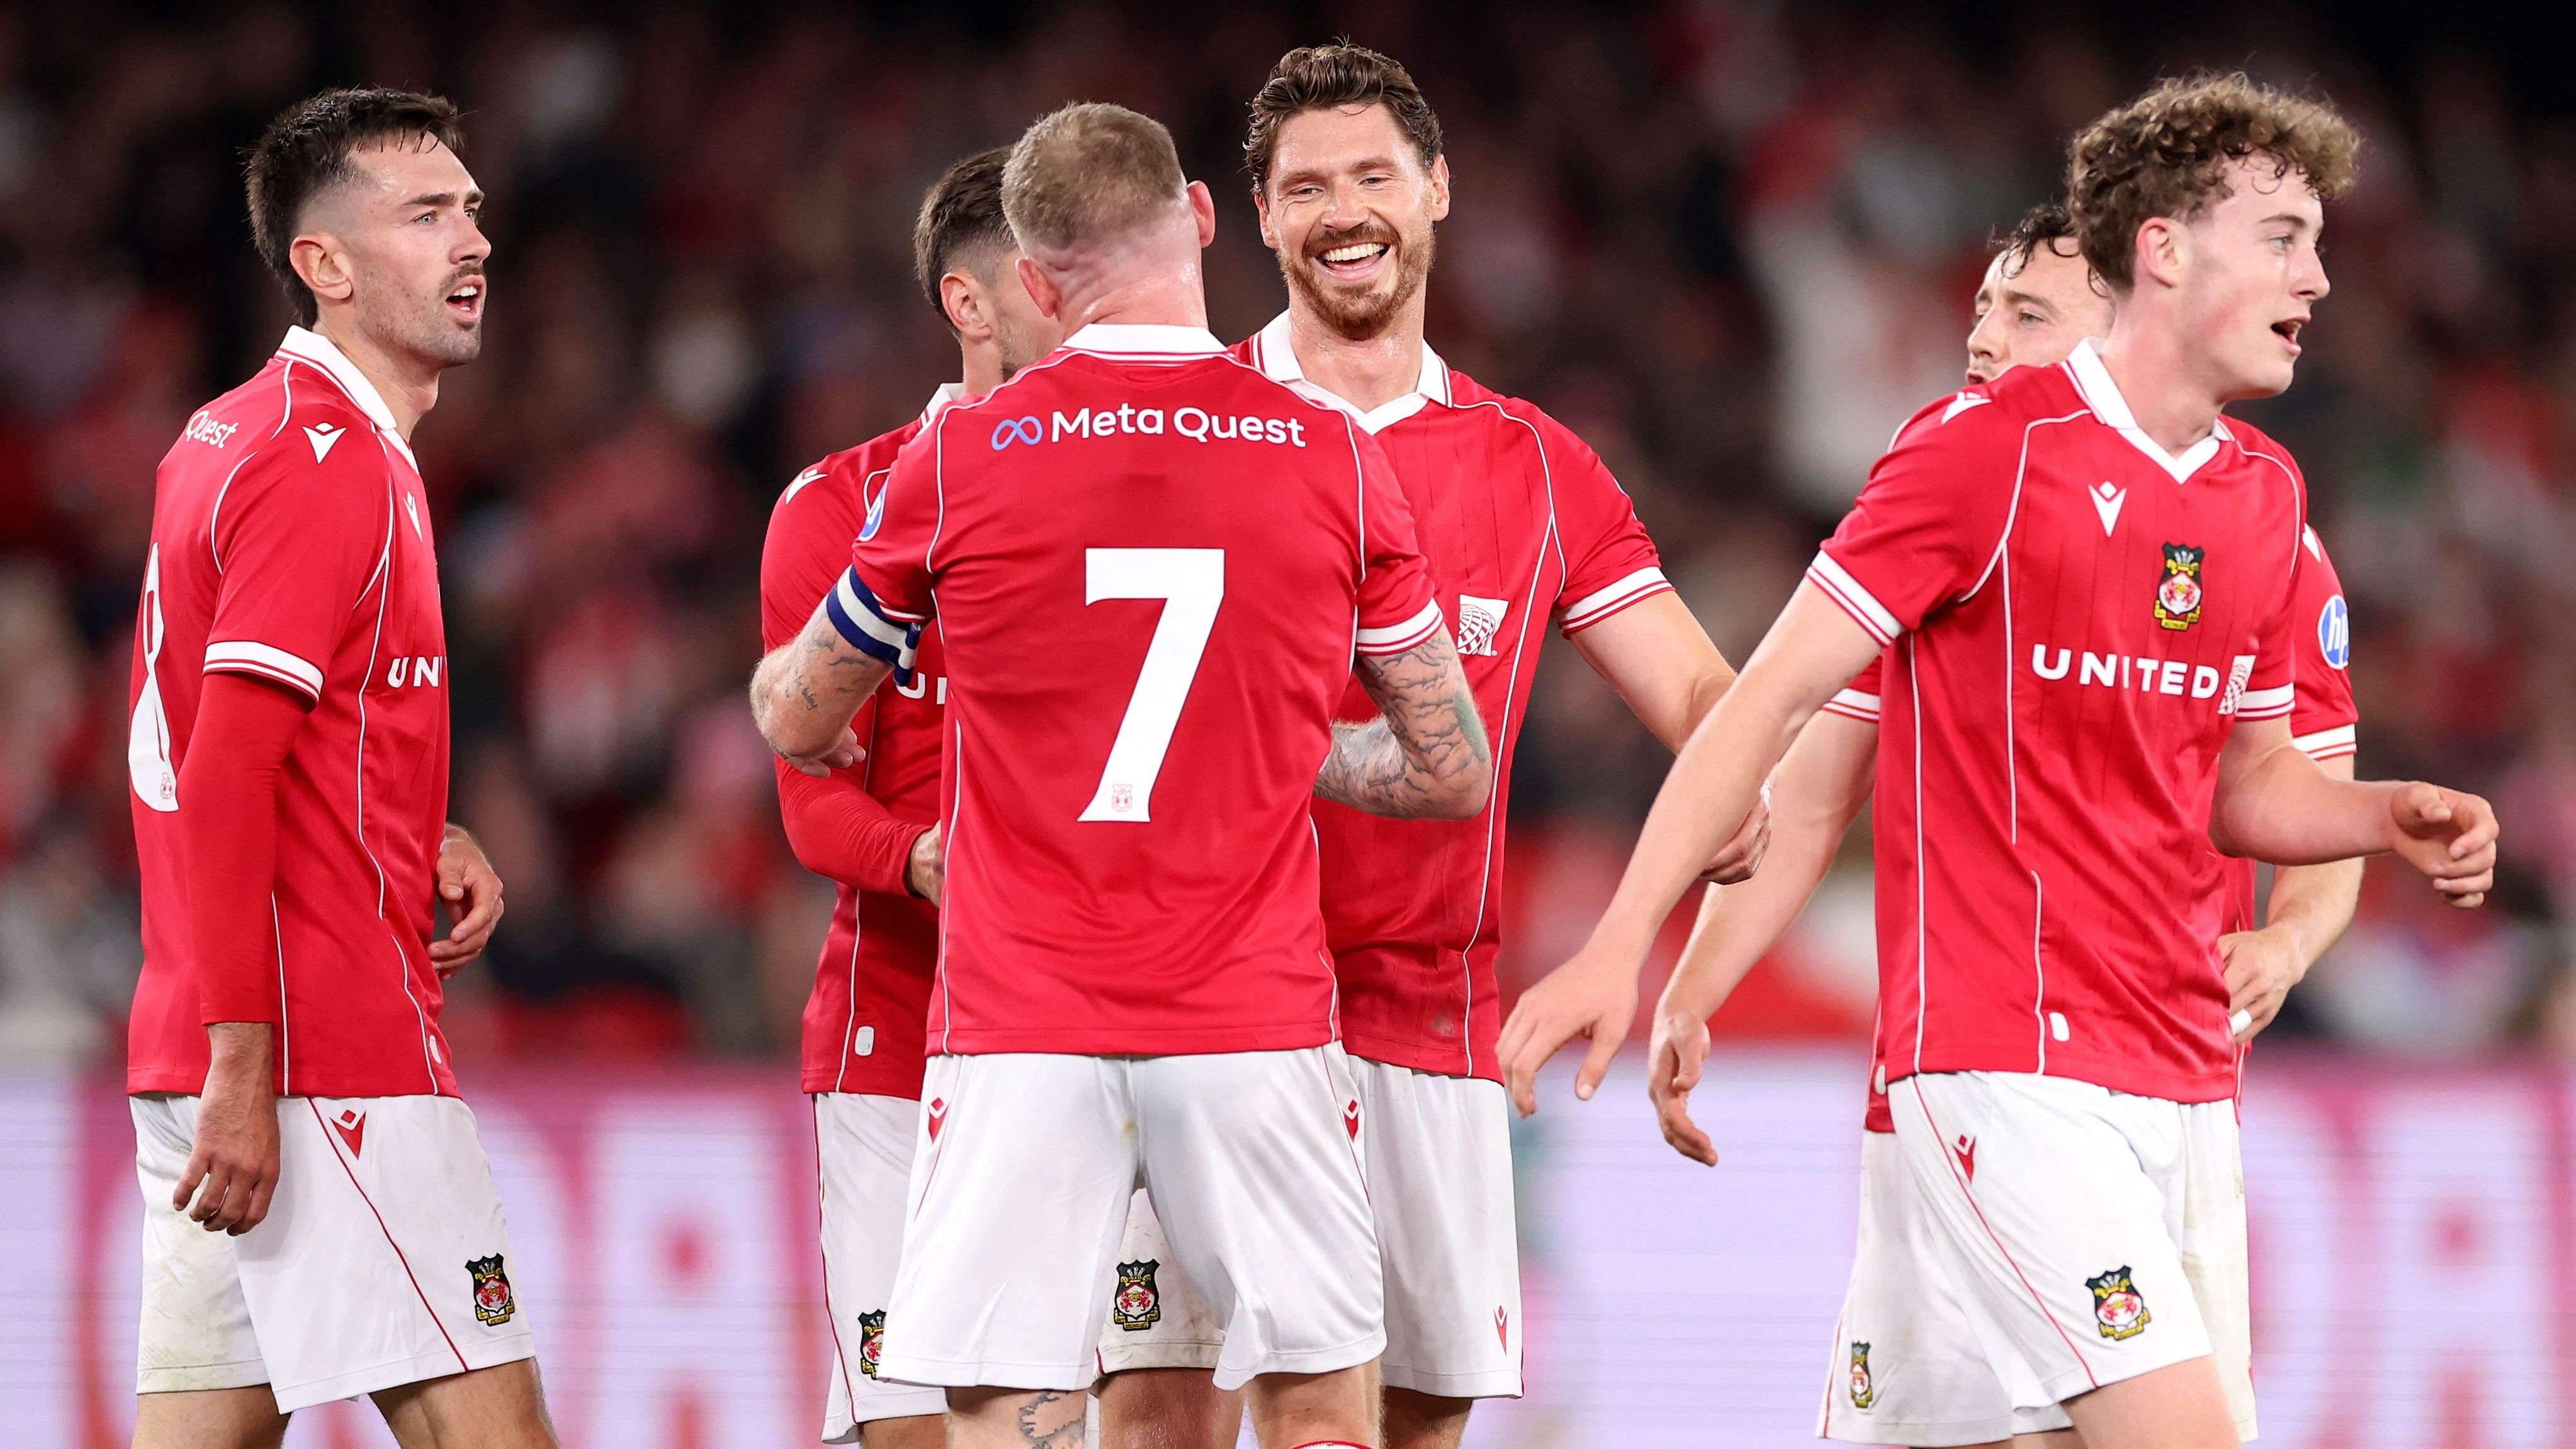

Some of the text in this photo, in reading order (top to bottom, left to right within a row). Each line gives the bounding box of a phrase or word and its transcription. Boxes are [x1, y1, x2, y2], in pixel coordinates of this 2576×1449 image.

[186, 410, 239, 449] Quest
[1051, 402, 1307, 448] Meta Quest
[1077, 547, 1226, 823] 7
[2032, 643, 2220, 699] UNITED
